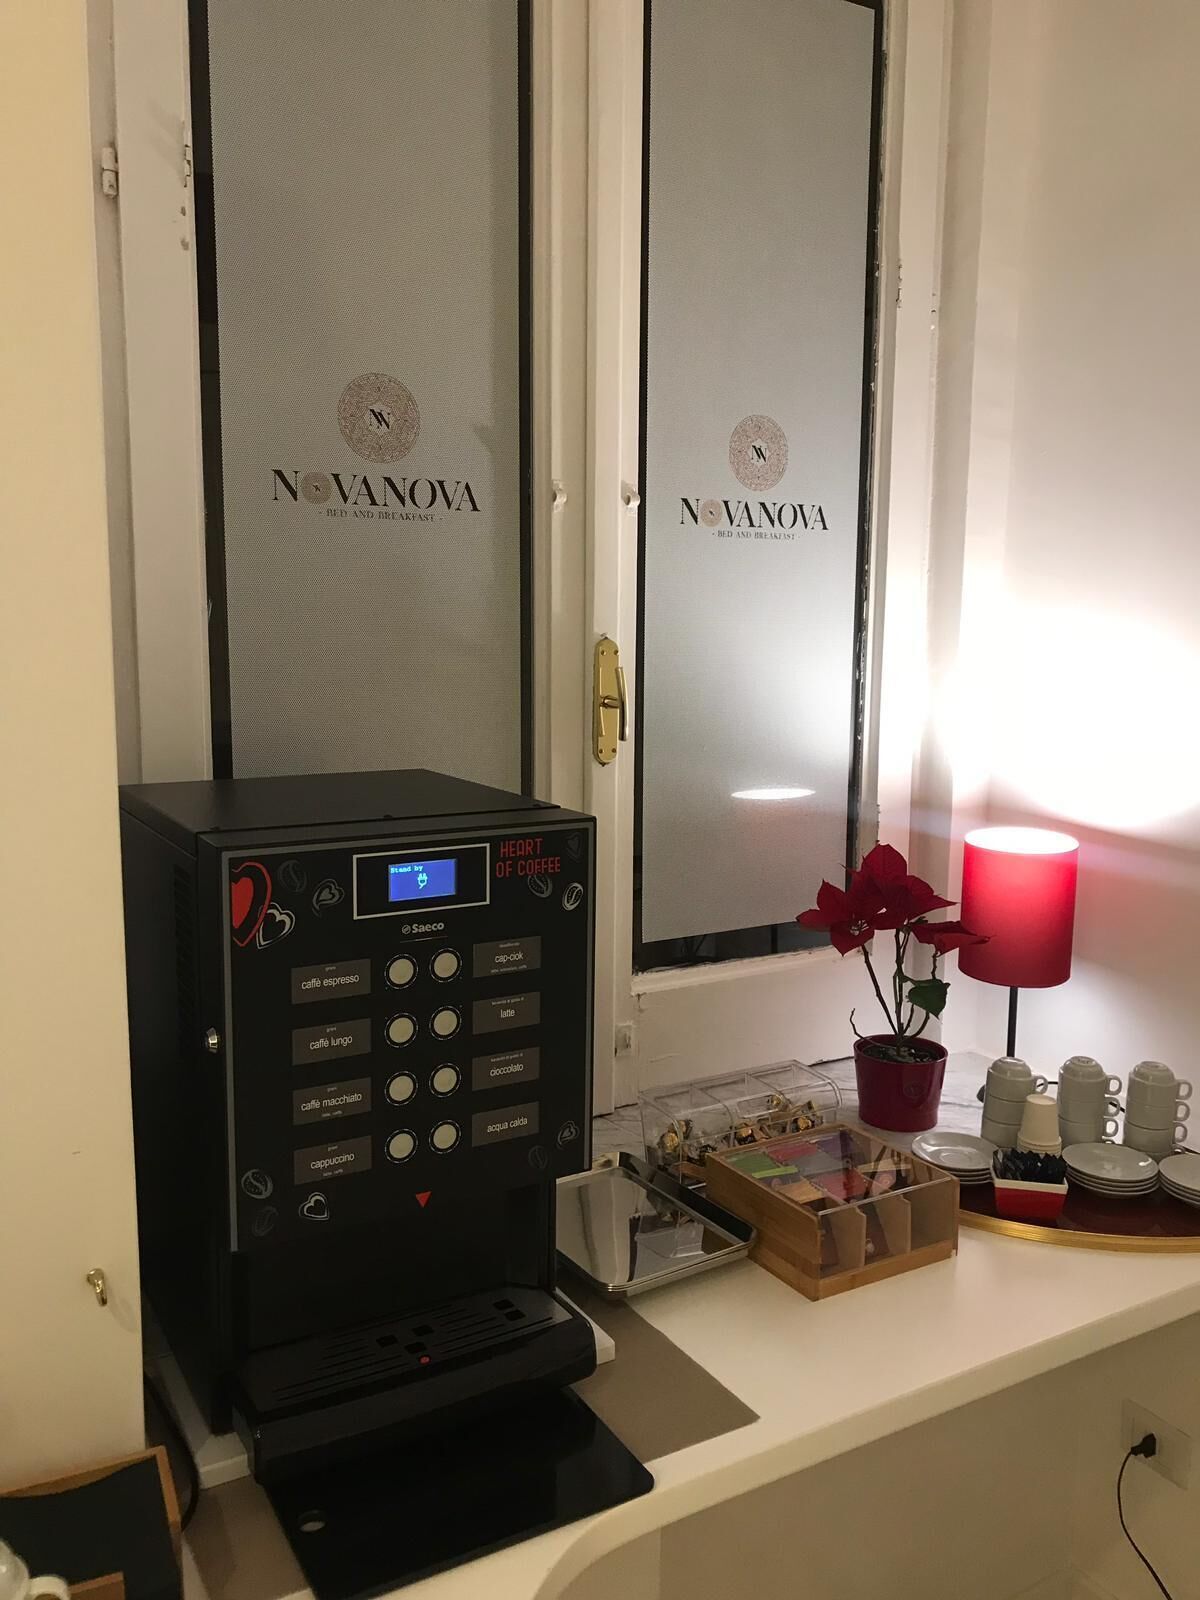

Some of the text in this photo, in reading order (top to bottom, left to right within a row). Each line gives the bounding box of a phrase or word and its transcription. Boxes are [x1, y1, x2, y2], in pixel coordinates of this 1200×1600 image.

[326, 508, 435, 522] BED AND BREAKFAST
[717, 530, 796, 541] BED AND BREAKFAST
[500, 838, 543, 858] HEART
[390, 864, 424, 874] Stand by
[496, 856, 561, 879] OF COFFEE
[412, 921, 445, 934] Saeco
[494, 951, 524, 965] cap-ciok
[323, 973, 360, 991] espresso
[500, 1007, 516, 1019] latte
[331, 1033, 353, 1050] lungo
[489, 1062, 524, 1077] cioccolato
[322, 1091, 363, 1109] macchiato
[487, 1116, 528, 1134] acqua calda
[310, 1151, 355, 1170] cappuccino
